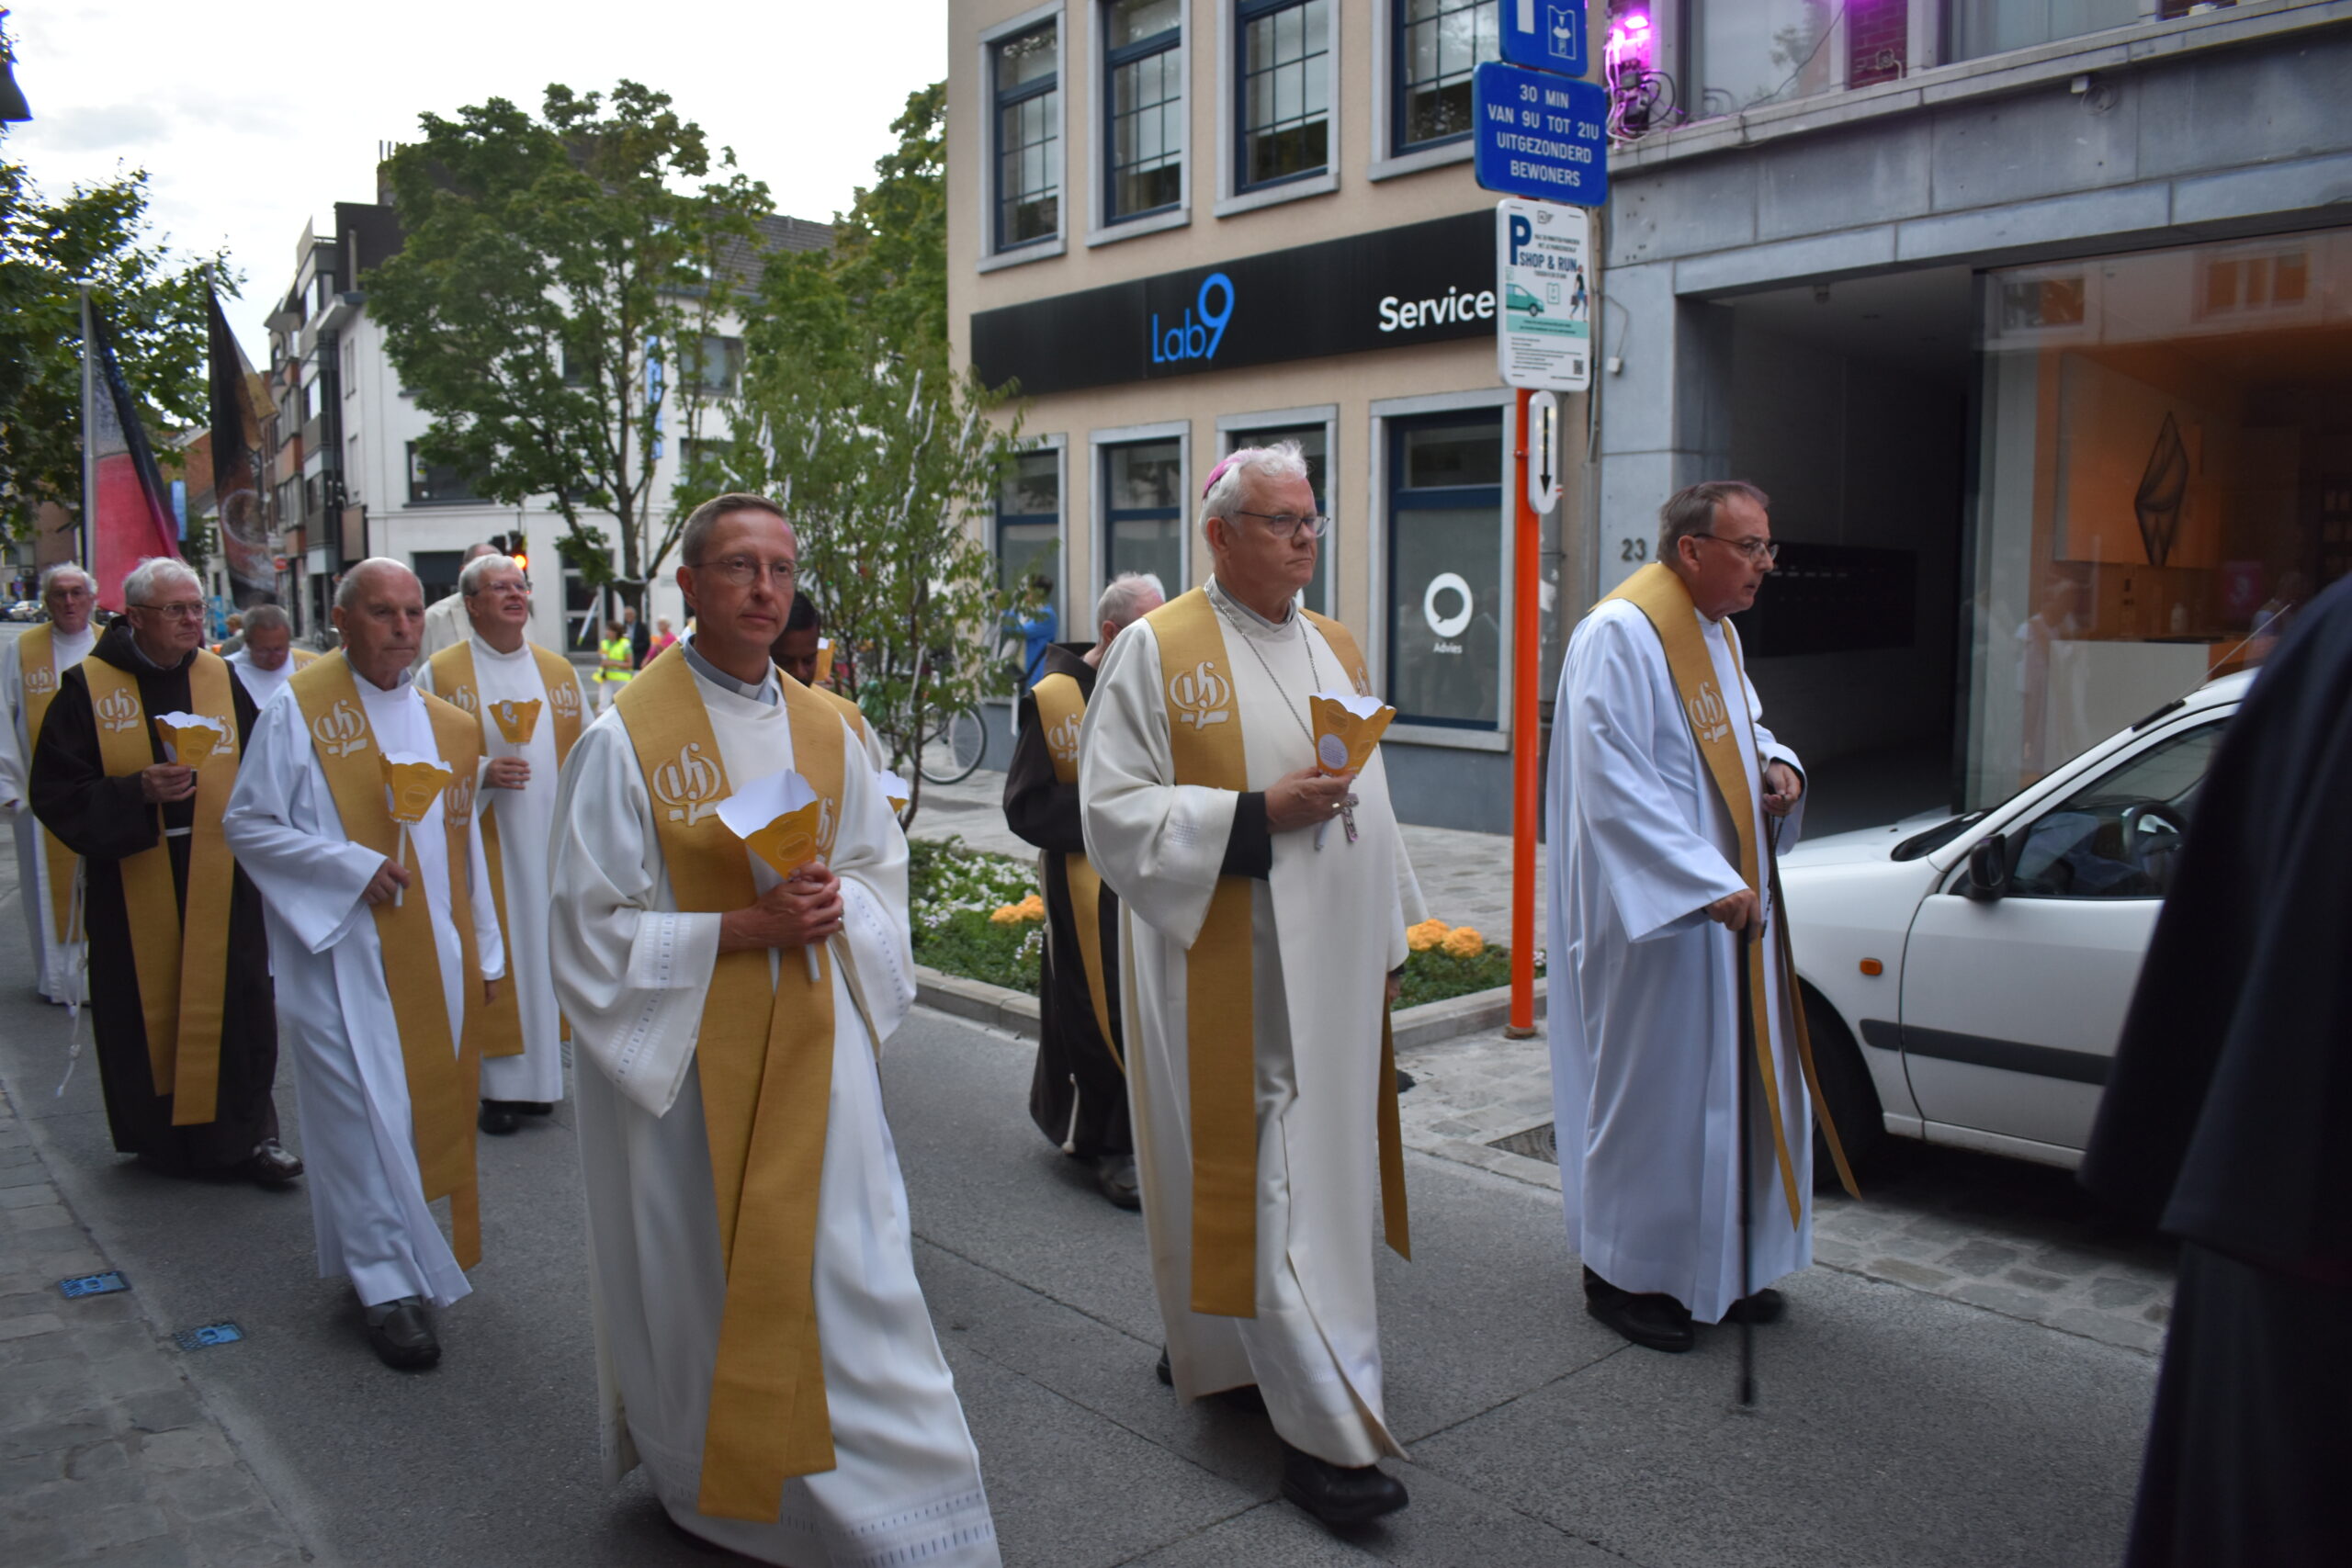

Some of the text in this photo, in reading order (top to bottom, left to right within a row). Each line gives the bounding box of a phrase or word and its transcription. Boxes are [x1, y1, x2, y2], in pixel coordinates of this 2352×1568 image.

[1520, 84, 1569, 109] 30 MIN
[1487, 104, 1599, 141] VAN 9U TOT 21U
[1497, 131, 1592, 164] UITGEZONDERD
[1510, 160, 1580, 187] BEWONERS
[1510, 214, 1532, 265] P
[1520, 252, 1577, 273] SHOP & RUN
[1152, 273, 1235, 363] Lab9
[1378, 286, 1496, 333] Service
[1621, 537, 1646, 561] 23
